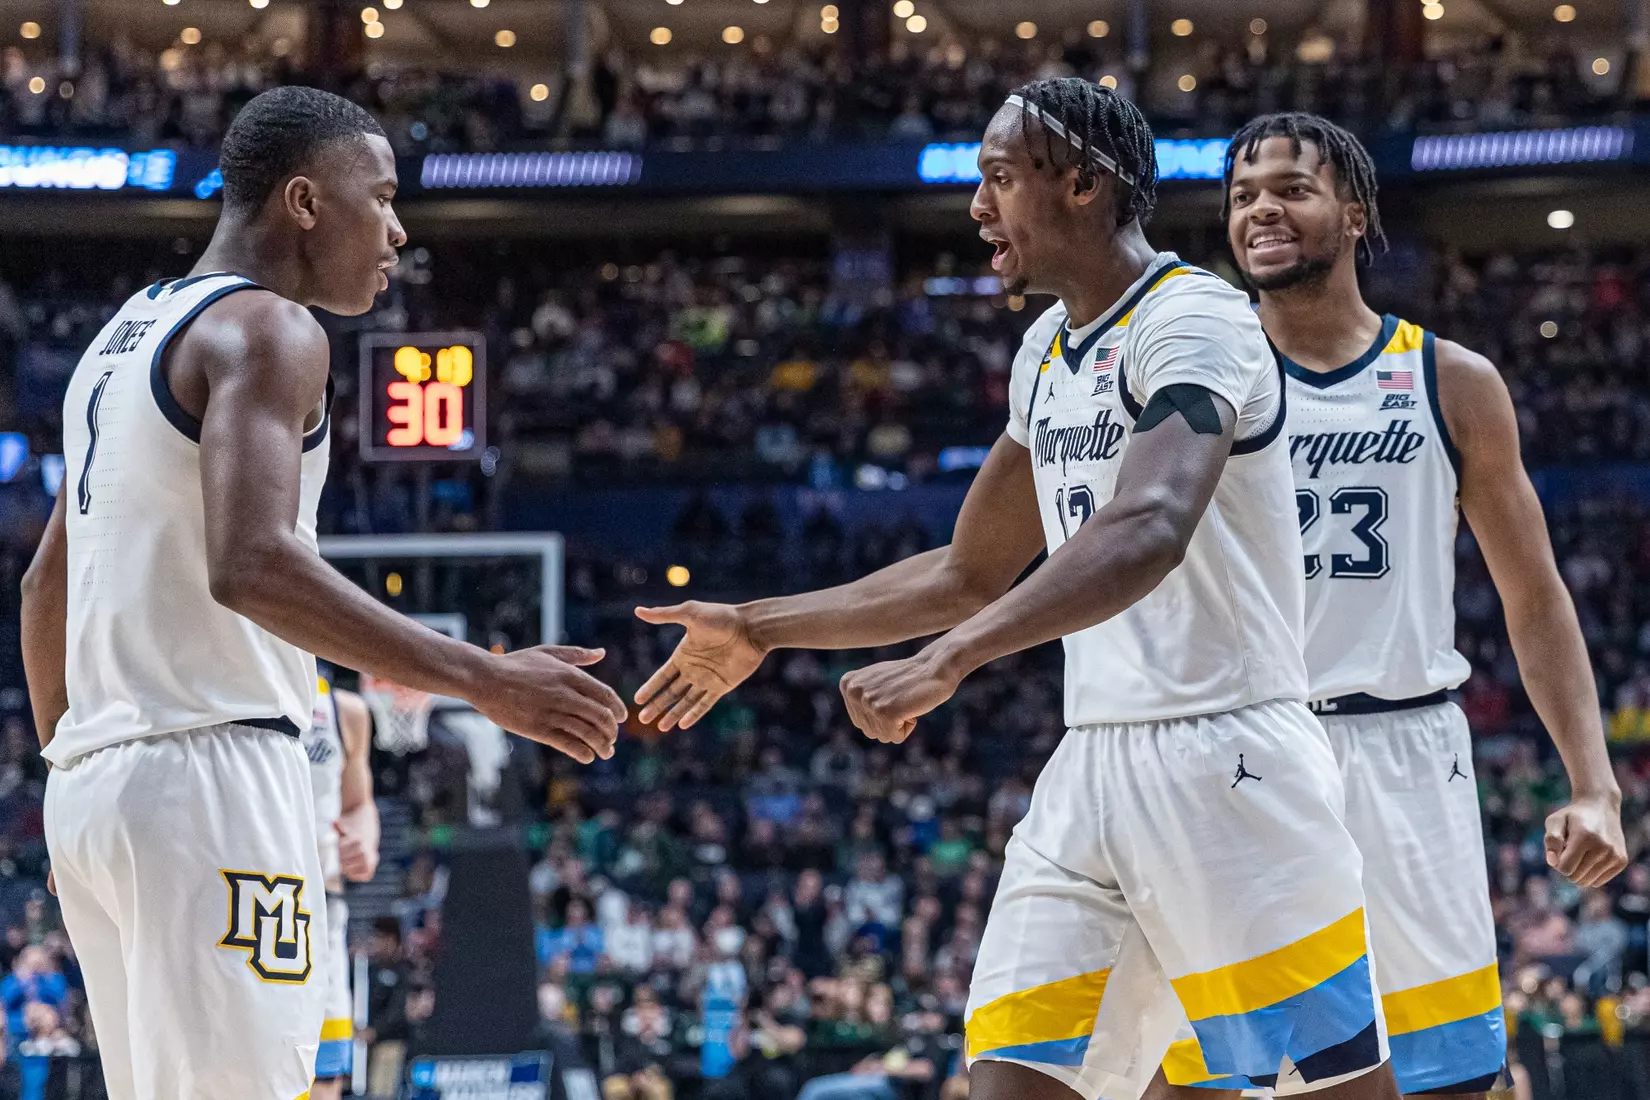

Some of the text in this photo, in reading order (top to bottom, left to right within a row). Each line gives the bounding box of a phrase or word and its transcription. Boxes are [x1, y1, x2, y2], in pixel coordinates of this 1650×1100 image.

[98, 319, 157, 356] JONES
[1093, 381, 1114, 393] EAST
[1096, 373, 1111, 385] BIG
[1385, 393, 1411, 401] BIG
[386, 381, 464, 447] 30
[1381, 400, 1418, 408] EAST
[77, 370, 114, 515] 1
[1034, 408, 1126, 478] Marquette
[1288, 419, 1426, 480] rquette
[215, 868, 313, 985] MU
